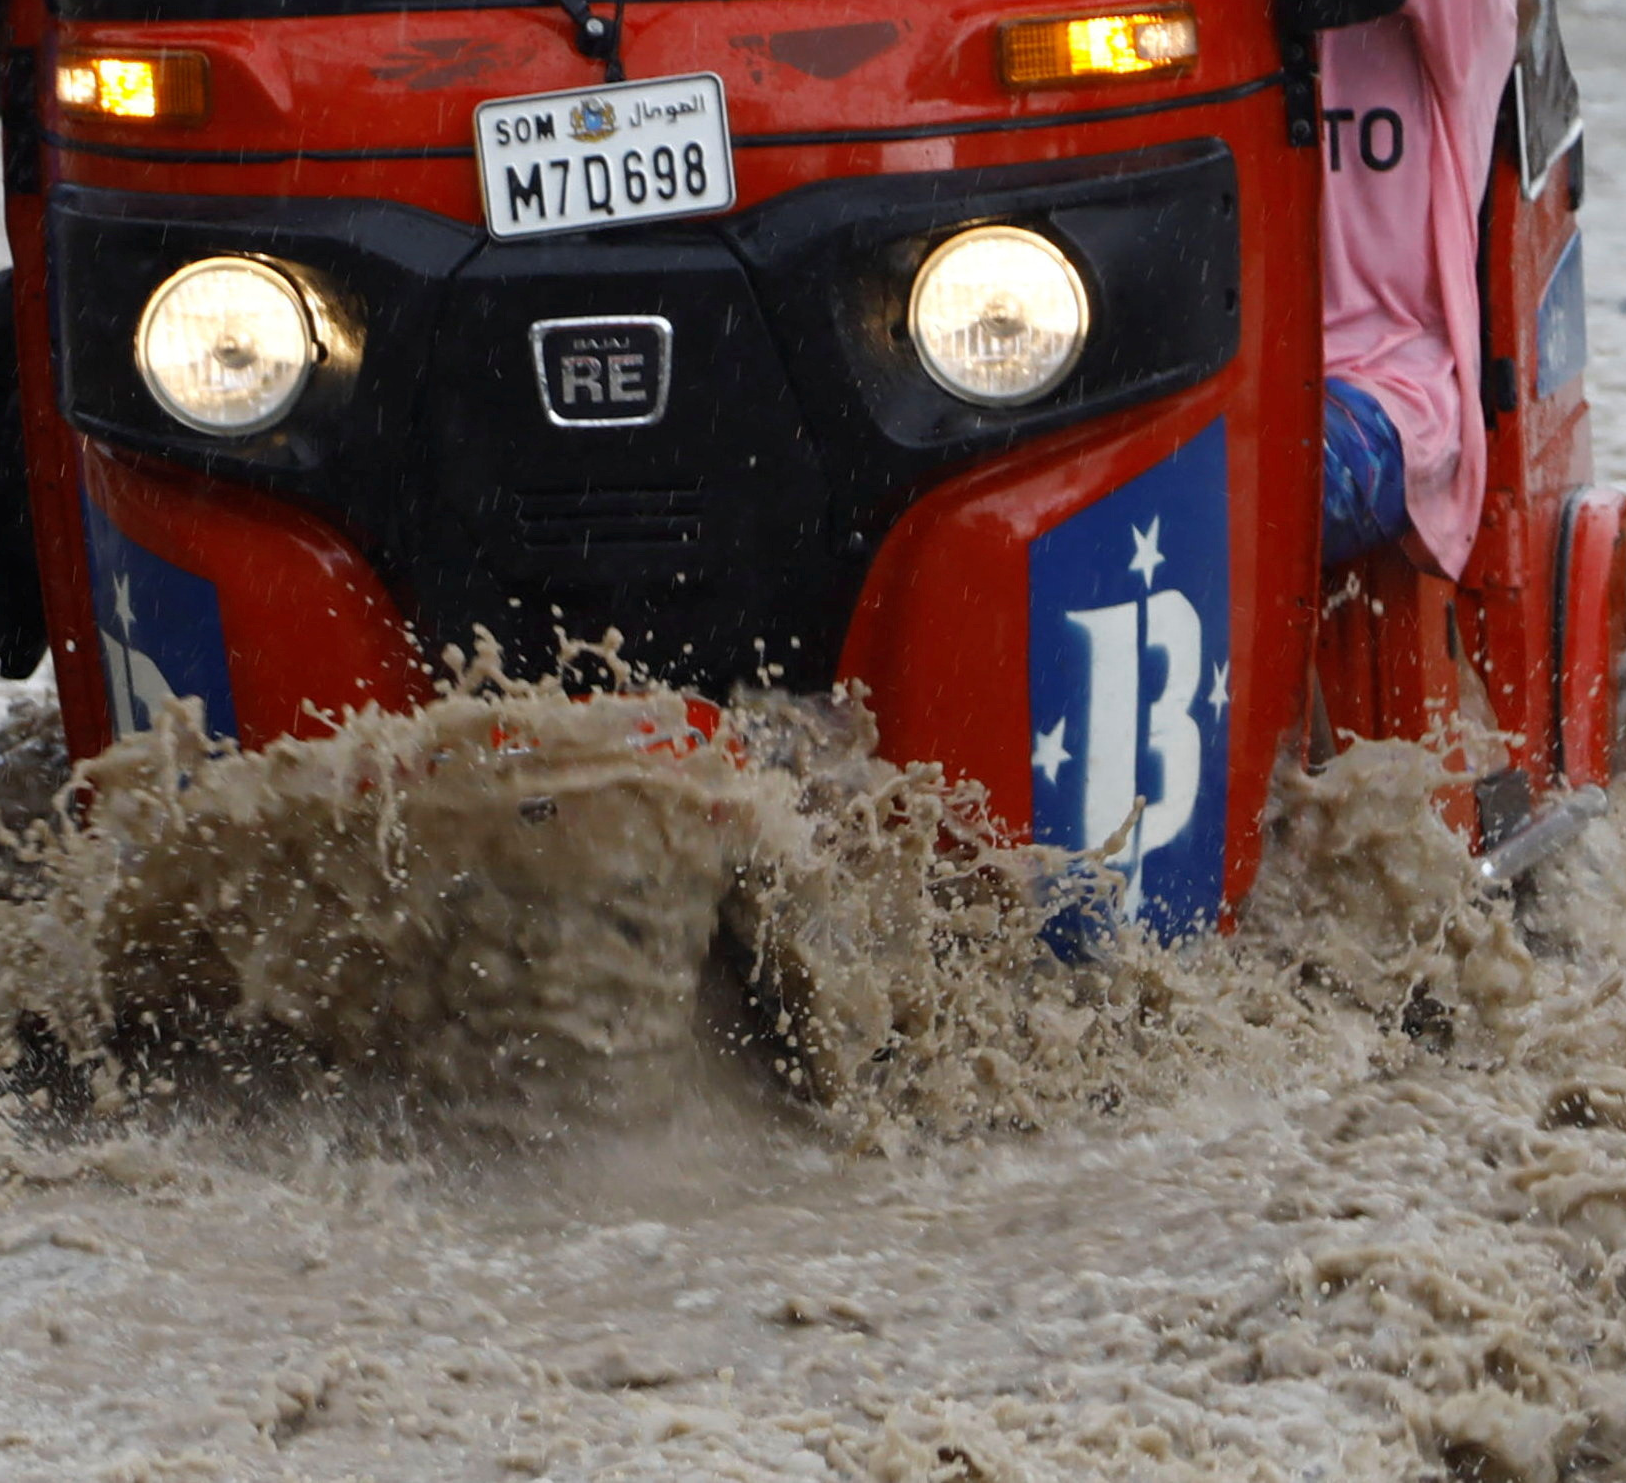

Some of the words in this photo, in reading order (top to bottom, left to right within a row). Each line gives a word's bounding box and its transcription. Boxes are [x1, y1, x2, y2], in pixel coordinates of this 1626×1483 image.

[495, 112, 556, 146] SOM
[1323, 106, 1404, 173] TO
[506, 141, 708, 222] M7Q698
[560, 354, 647, 405] RE
